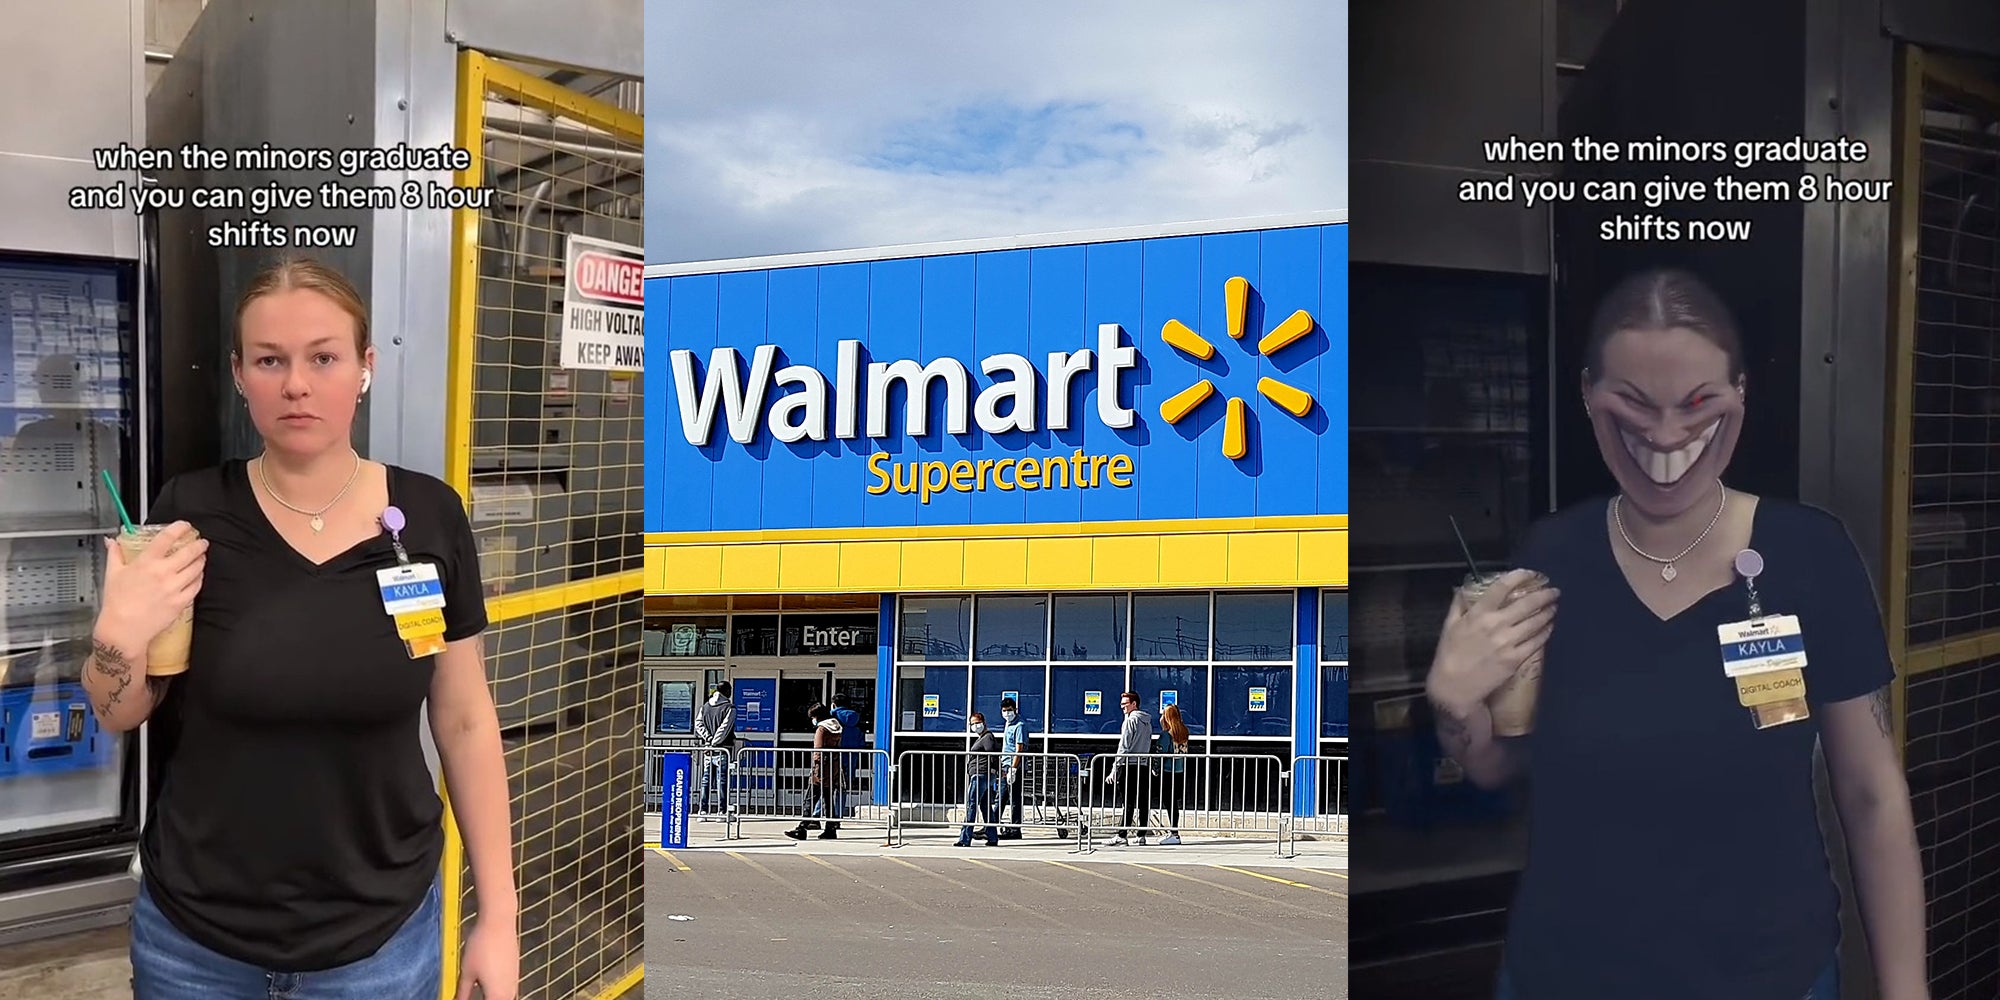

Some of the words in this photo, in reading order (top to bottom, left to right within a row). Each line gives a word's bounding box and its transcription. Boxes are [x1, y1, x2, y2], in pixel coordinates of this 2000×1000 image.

[570, 307, 601, 332] HIGH
[577, 342, 611, 365] KEEP
[669, 323, 1136, 446] Walmart
[867, 449, 1134, 503] Supercentre
[393, 583, 429, 597] KAYLA
[398, 621, 421, 630] DIGITAL
[803, 625, 860, 646] Enter
[1738, 628, 1769, 638] Walmart
[1738, 639, 1786, 656] KAYLA
[1740, 684, 1772, 695] DIGITAL
[1773, 679, 1801, 689] COACH
[676, 769, 684, 797] GRAND
